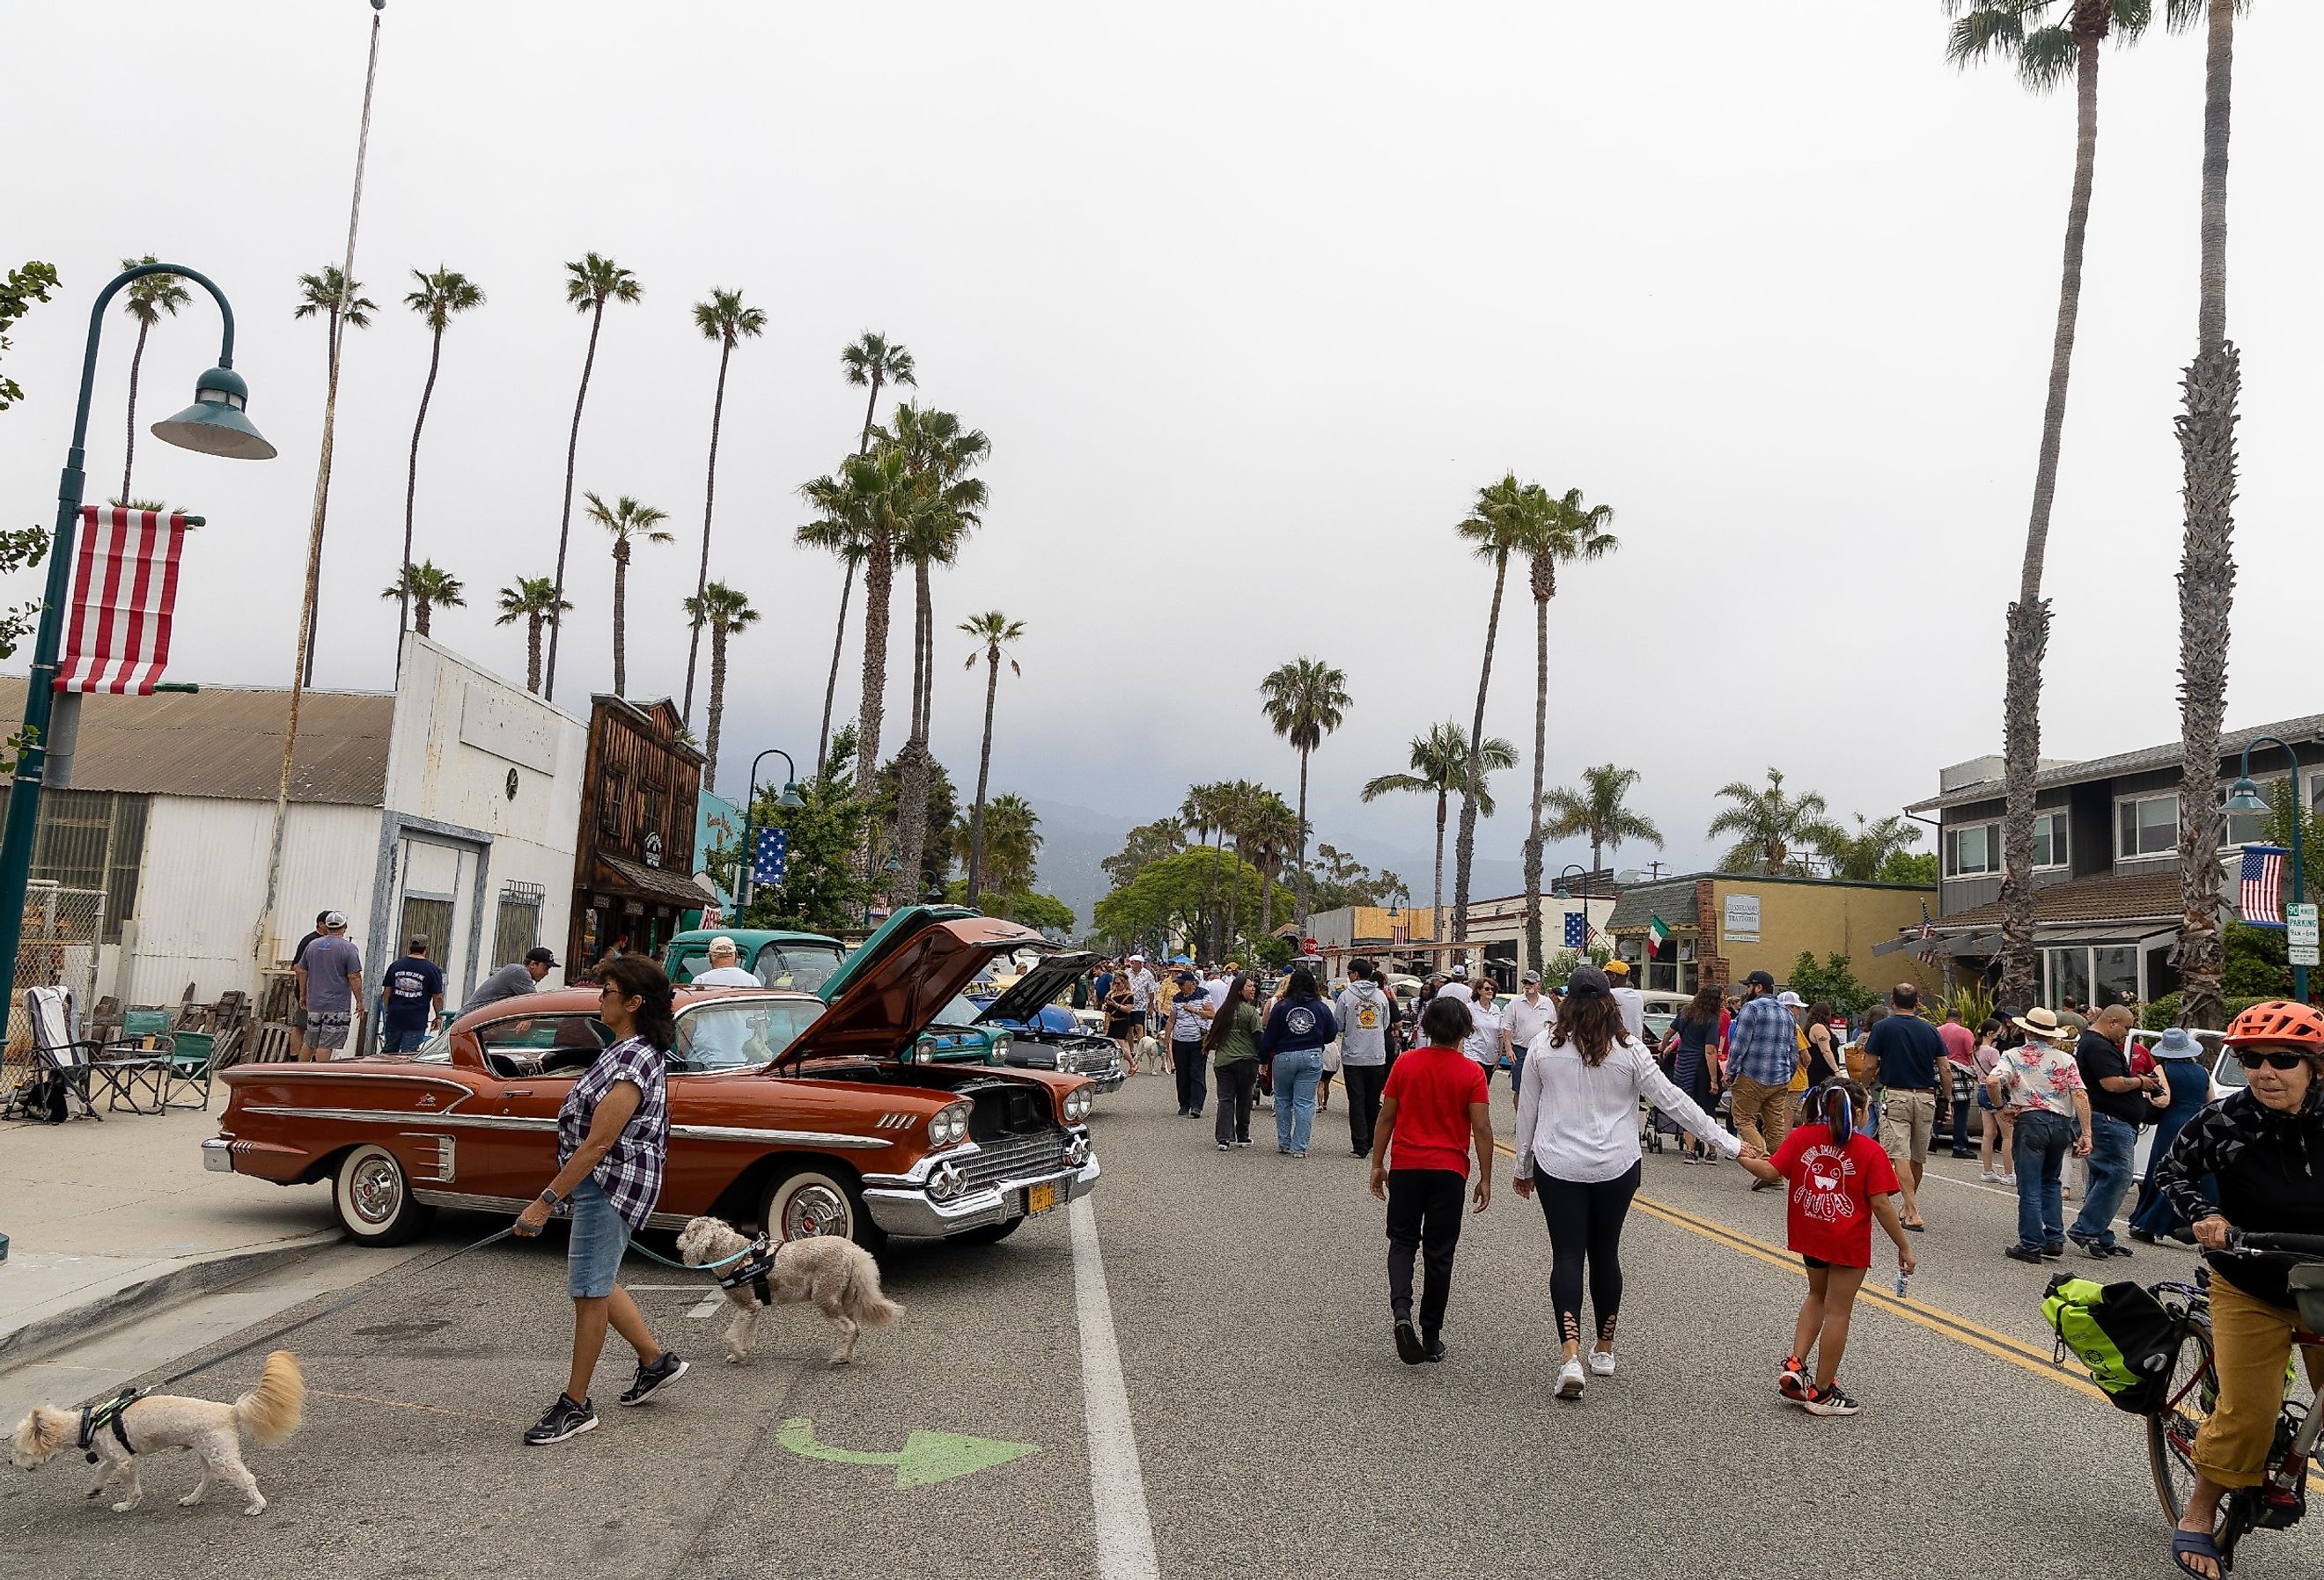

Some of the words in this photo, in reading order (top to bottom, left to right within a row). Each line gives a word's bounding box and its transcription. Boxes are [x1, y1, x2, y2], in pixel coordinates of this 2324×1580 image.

[2289, 905, 2298, 915] 90
[2290, 919, 2316, 928] PARKING
[1304, 942, 1318, 951] STOP
[744, 1262, 761, 1274] Rocky
